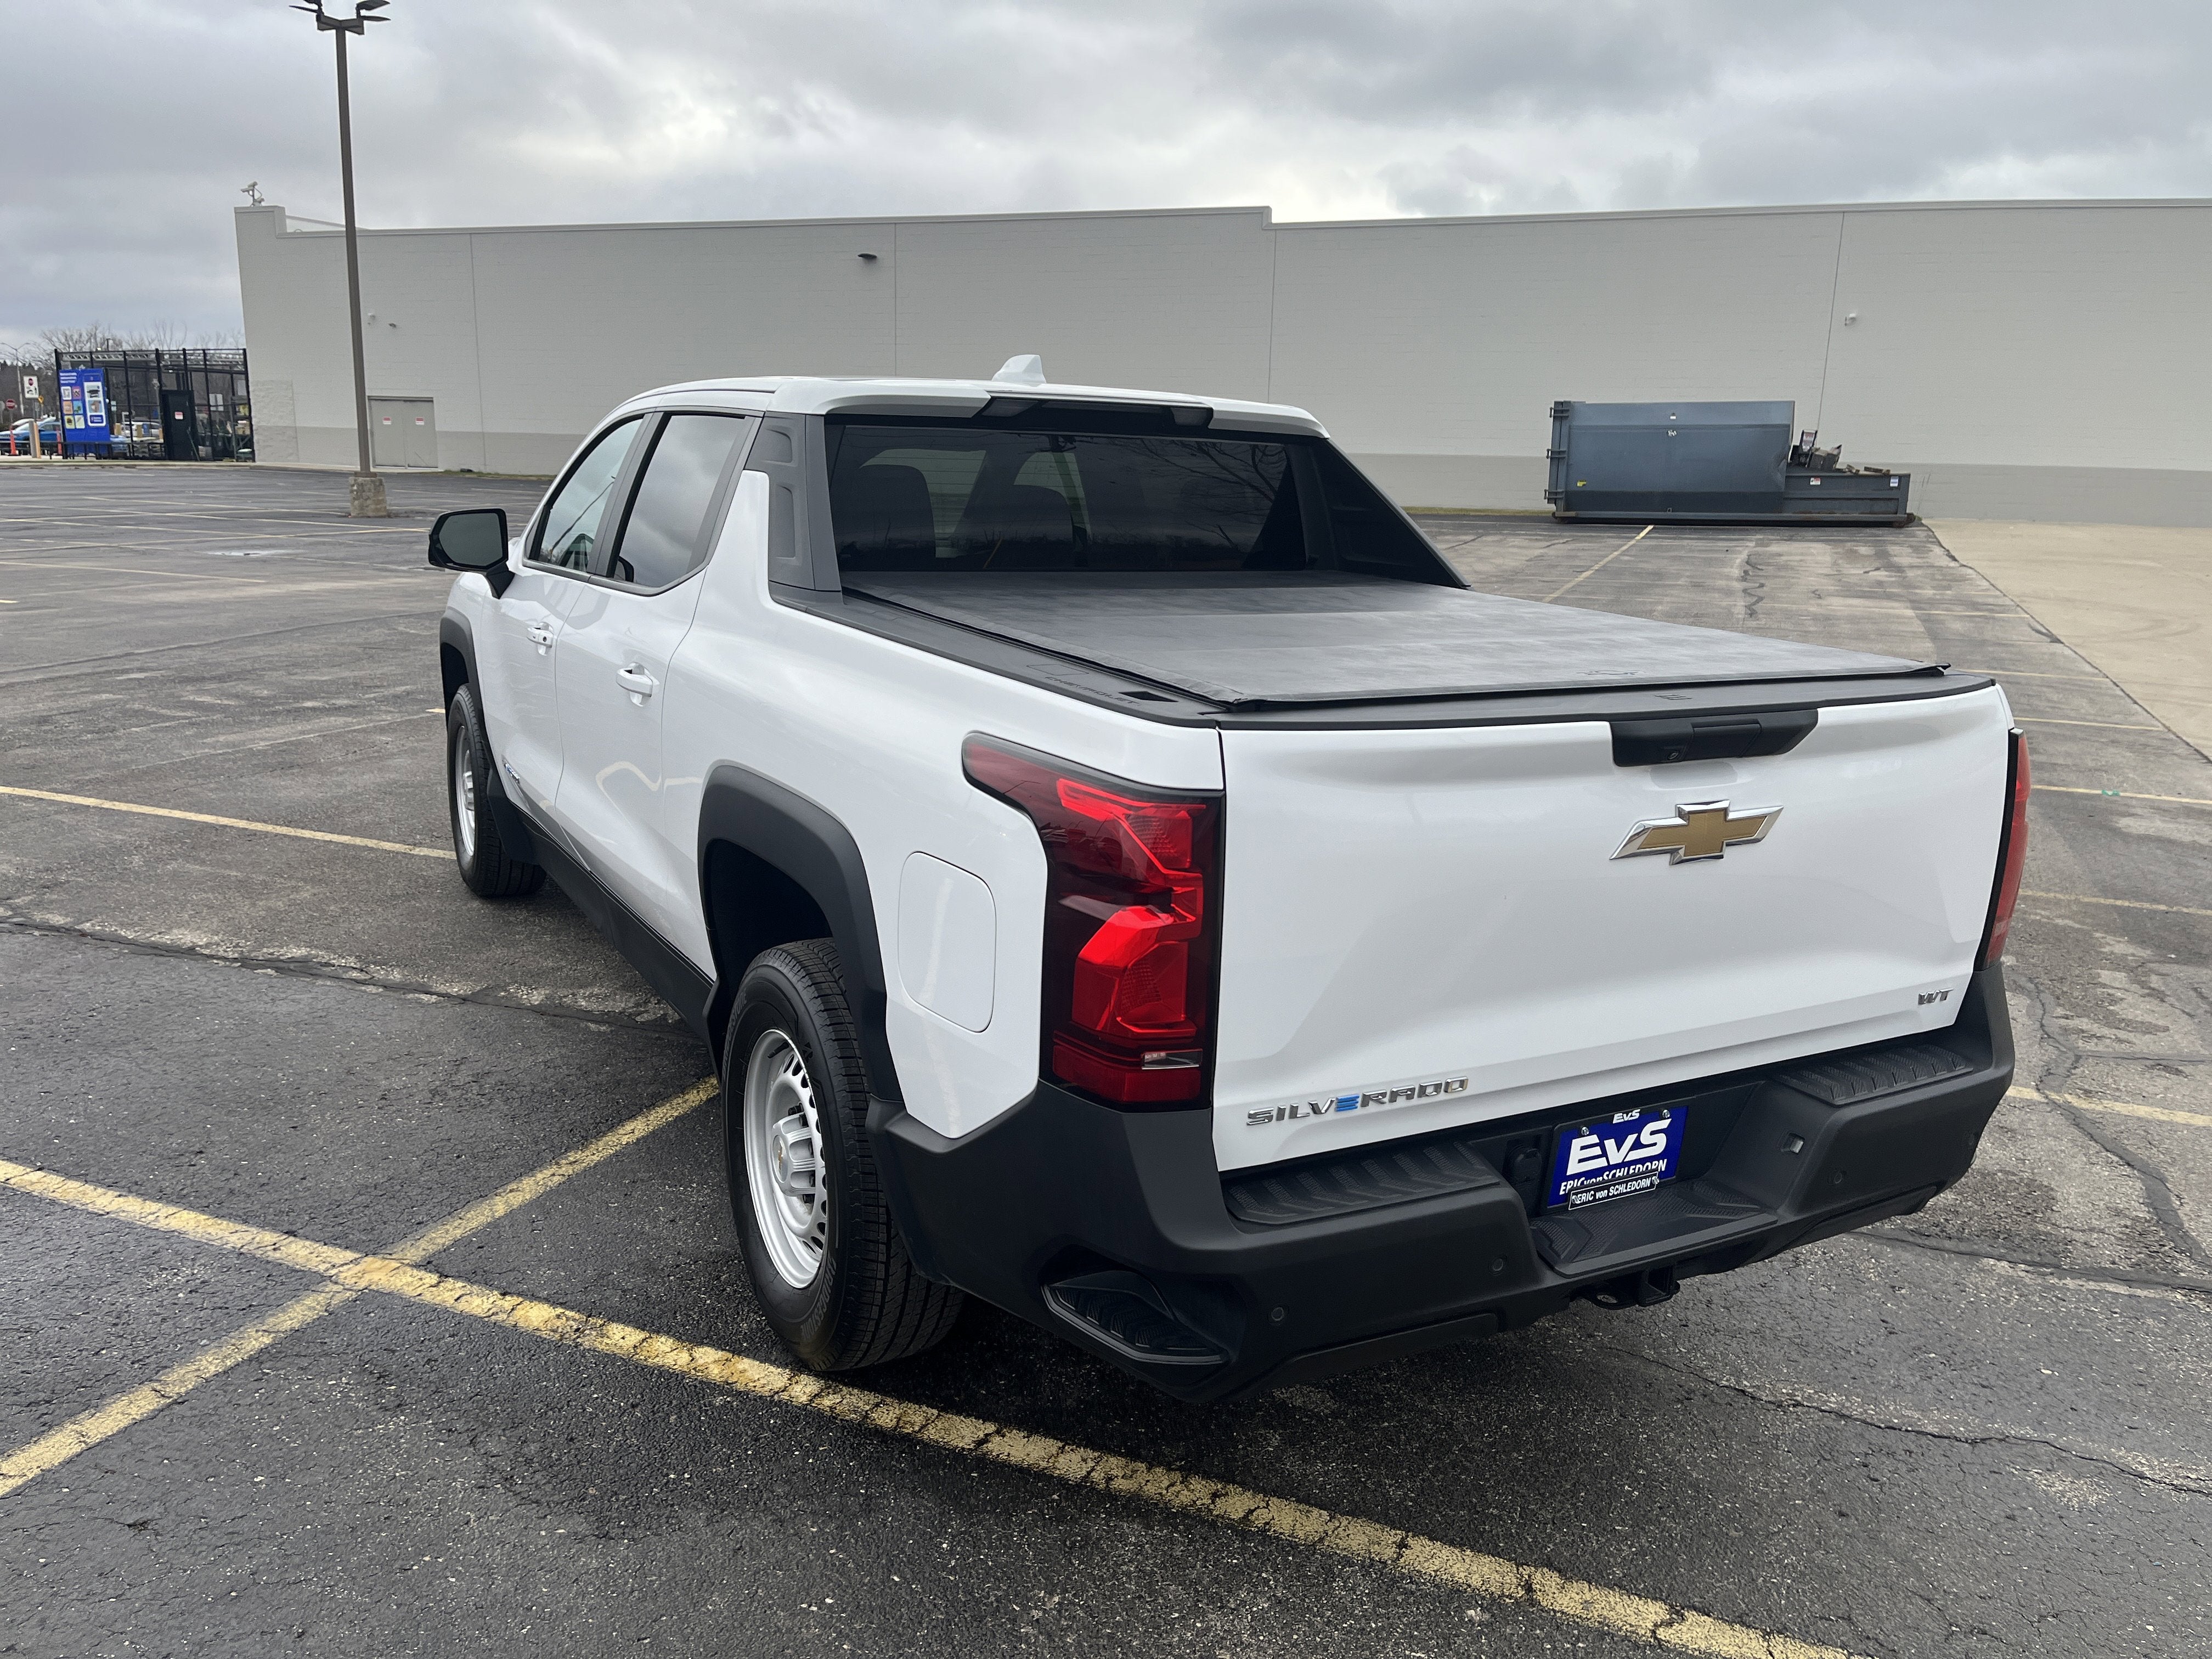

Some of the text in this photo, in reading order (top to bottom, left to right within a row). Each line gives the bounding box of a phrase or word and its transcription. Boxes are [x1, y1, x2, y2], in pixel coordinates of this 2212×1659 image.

[1045, 676, 1141, 706] CHEVROLET
[1918, 988, 1954, 1005] WT
[1246, 1076, 1469, 1126] SILVERADO
[1596, 1189, 1608, 1199] von
[1609, 1177, 1651, 1196] SCHLEDORN
